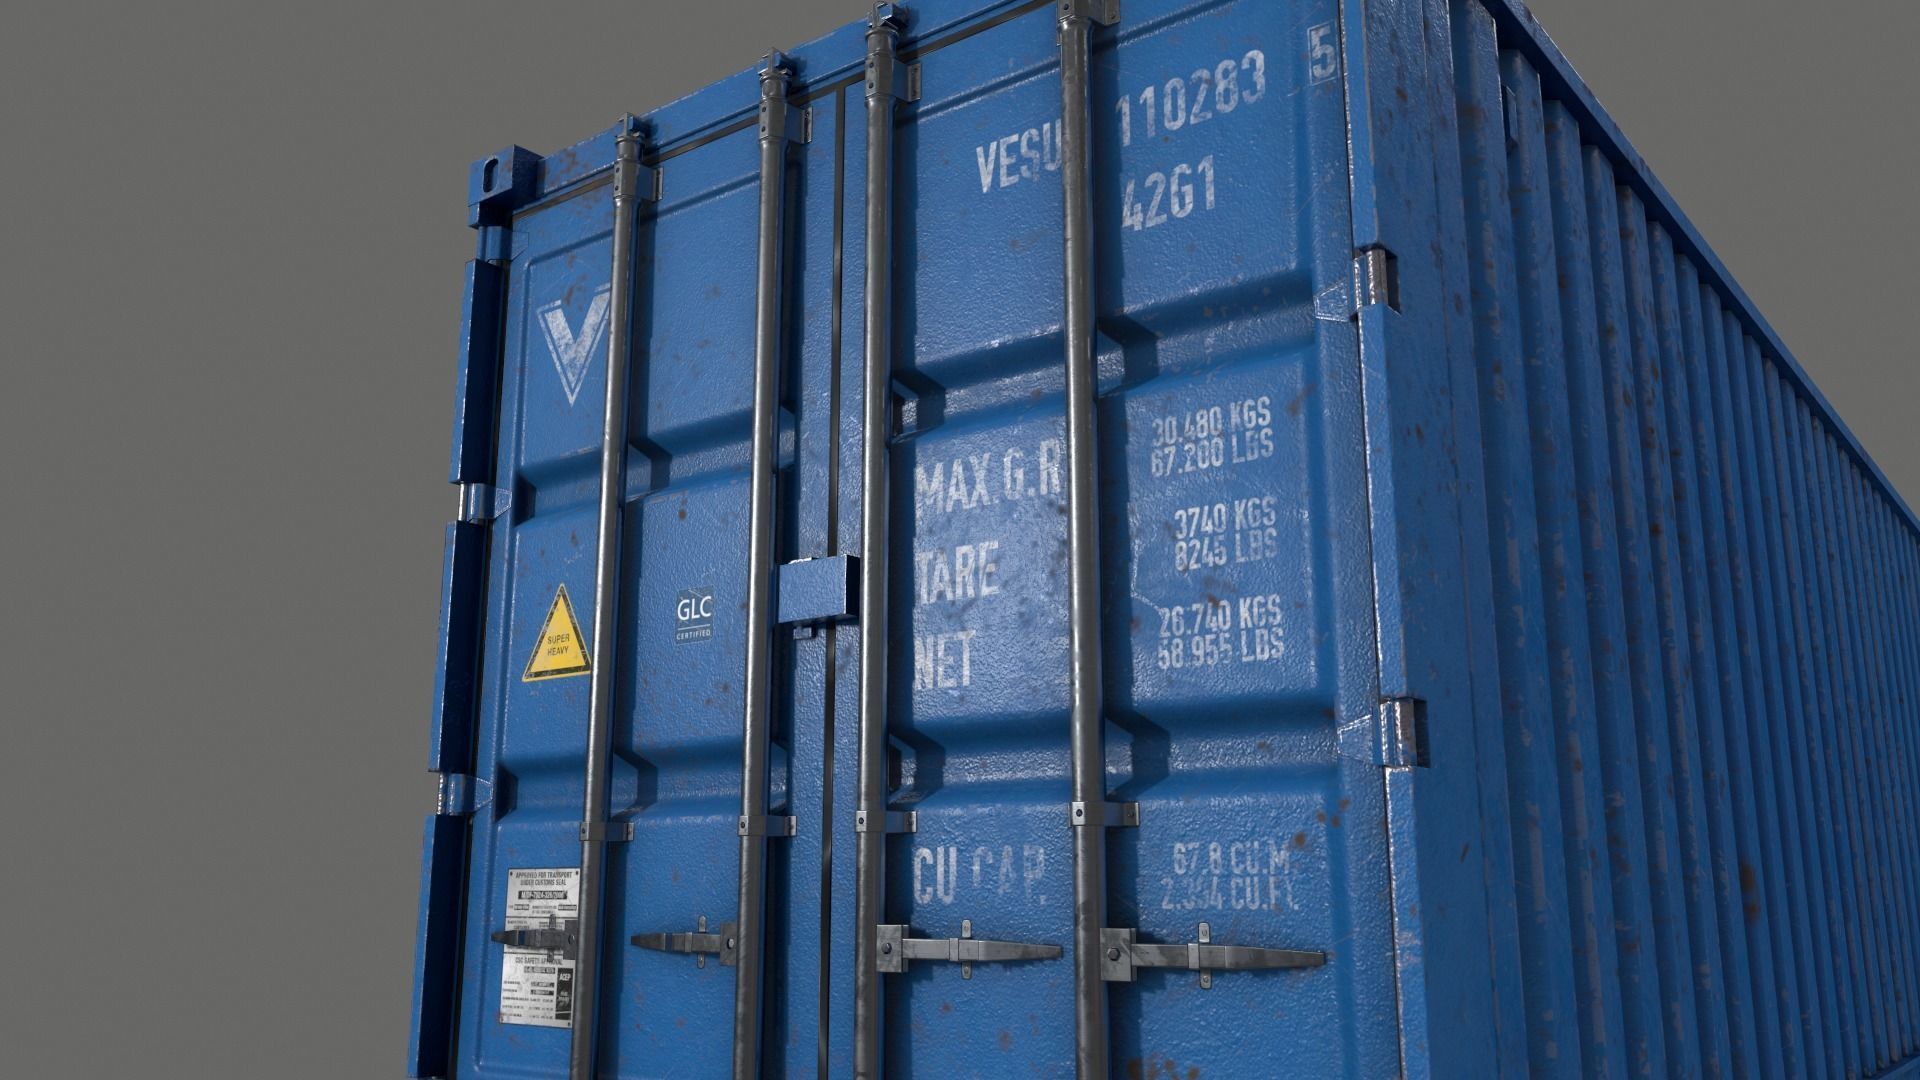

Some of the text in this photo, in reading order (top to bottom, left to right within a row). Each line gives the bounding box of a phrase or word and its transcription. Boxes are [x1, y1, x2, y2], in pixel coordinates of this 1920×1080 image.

[976, 26, 1337, 193] VESU 110283 5
[1122, 155, 1215, 231] 42G1
[1152, 397, 1271, 446] 30.480 KGS
[1152, 428, 1274, 476] 67.200 LBS
[1175, 496, 1276, 539] 3740 KGS
[1175, 527, 1277, 571] 8245 LBS
[914, 541, 1000, 604] TARE
[677, 595, 712, 620] GLC
[1160, 594, 1281, 637] 26.740 KGS
[547, 633, 570, 645] SUPER
[547, 645, 569, 656] HEAVY
[676, 629, 711, 641] CERTIFIED
[1241, 627, 1284, 662] LBS
[914, 630, 976, 688] NET
